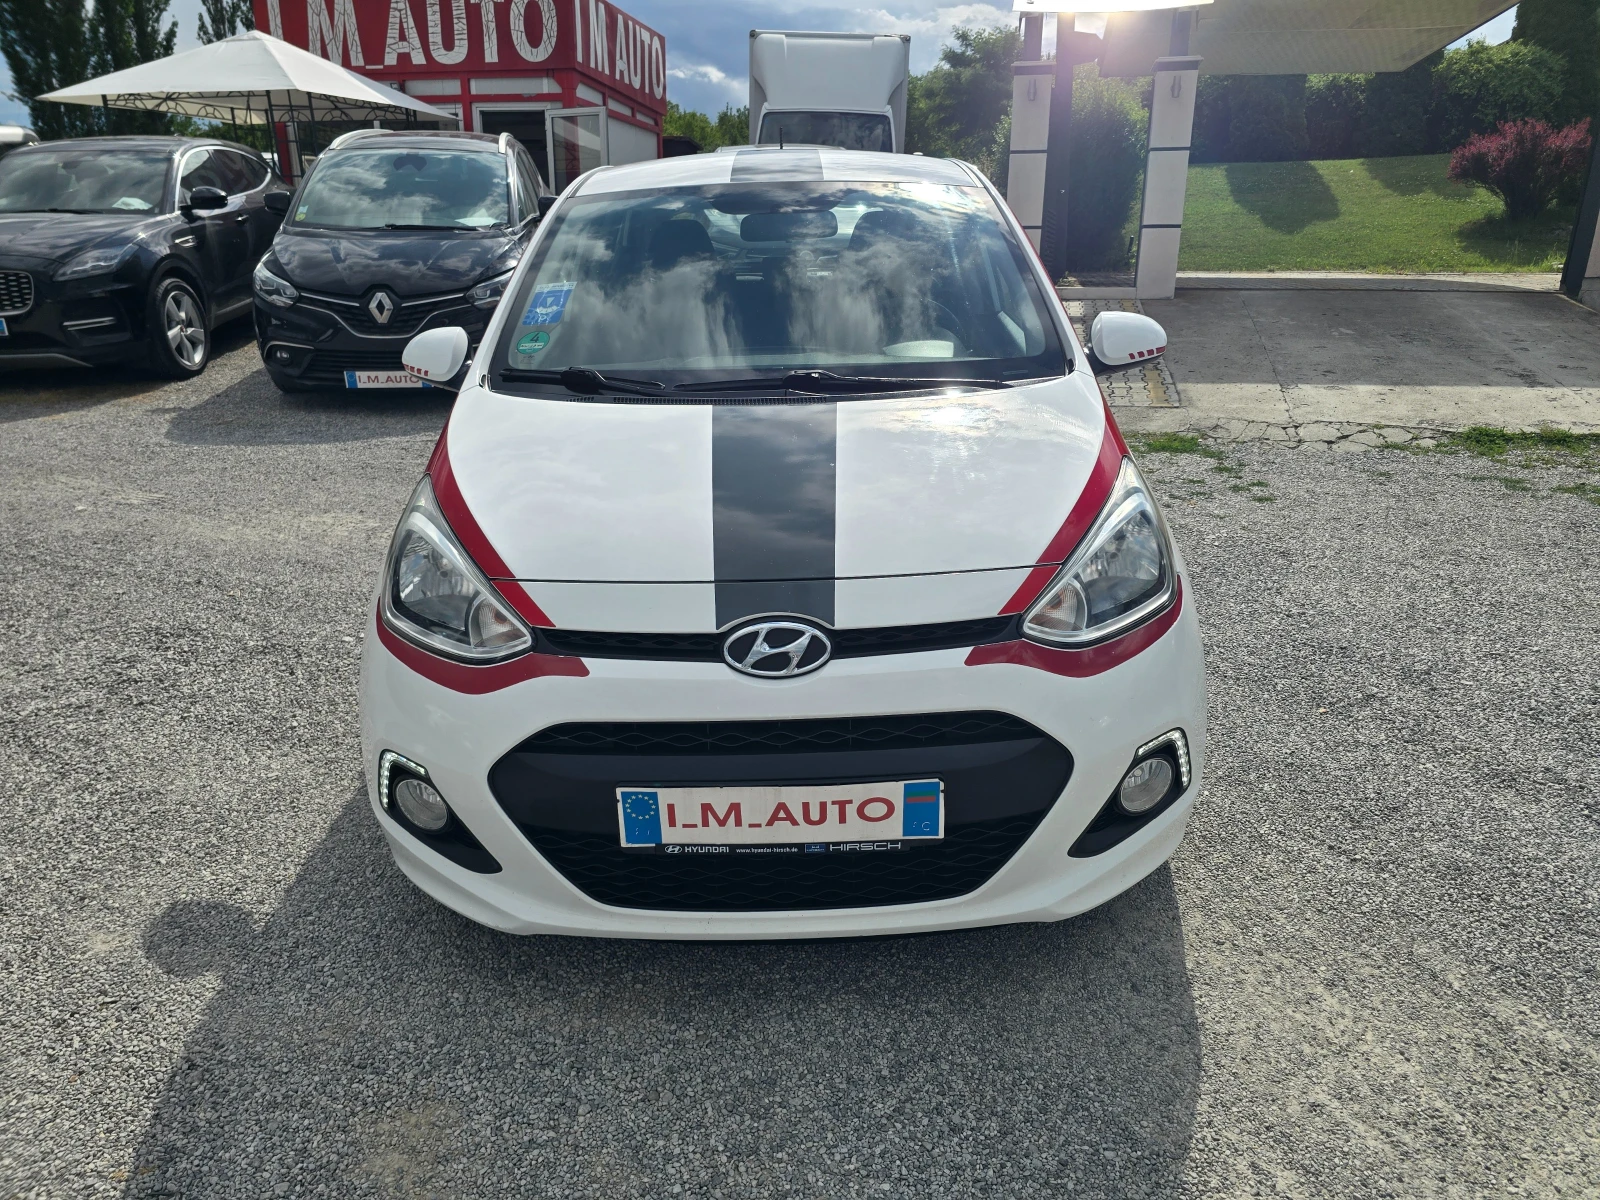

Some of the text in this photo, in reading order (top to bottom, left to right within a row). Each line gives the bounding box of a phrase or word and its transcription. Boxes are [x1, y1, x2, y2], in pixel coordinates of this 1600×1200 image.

[615, 14, 664, 100] AUTO
[530, 332, 540, 343] 4
[666, 796, 896, 829] I_M_AUTO
[830, 841, 902, 852] HIRSCH
